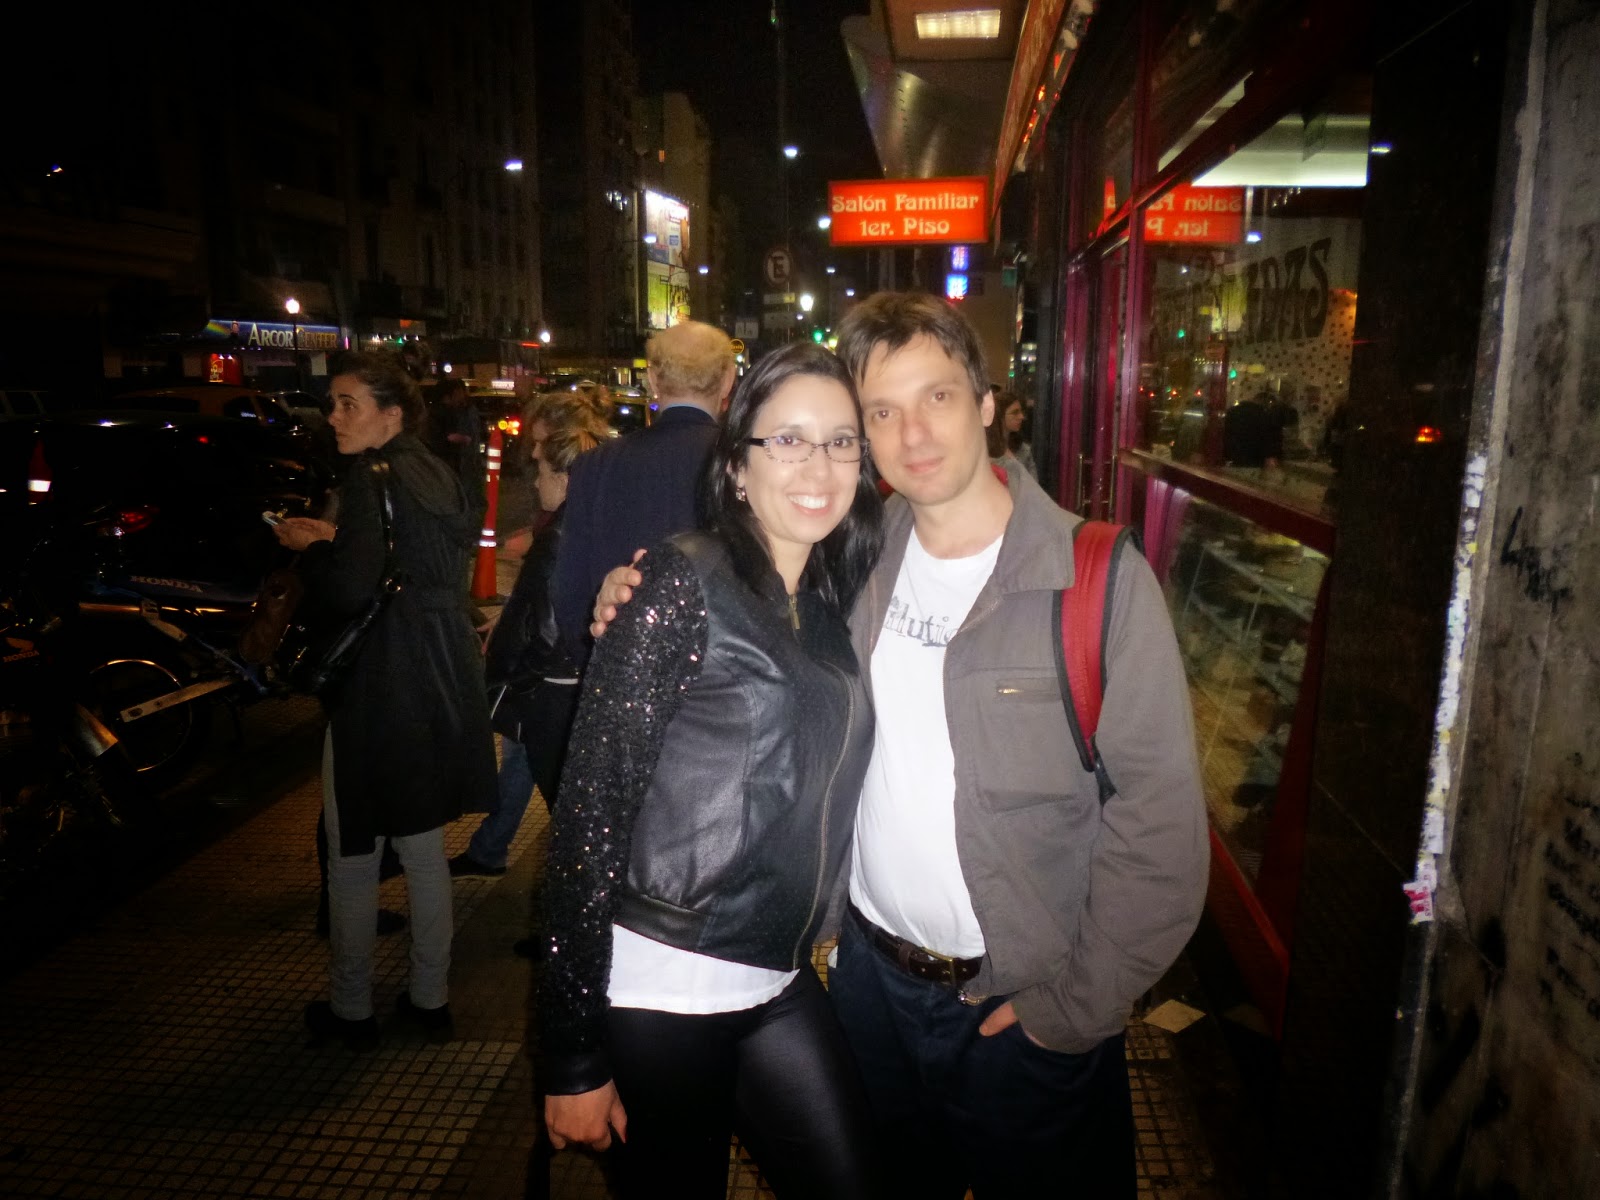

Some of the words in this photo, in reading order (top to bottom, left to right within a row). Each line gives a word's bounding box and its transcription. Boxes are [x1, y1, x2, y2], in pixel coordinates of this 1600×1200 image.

[832, 195, 887, 213] Salón
[895, 192, 979, 212] Familiar
[903, 217, 950, 236] Piso
[248, 322, 294, 347] ARCOR
[130, 575, 204, 593] HONDA
[2, 650, 40, 663] HONDA
